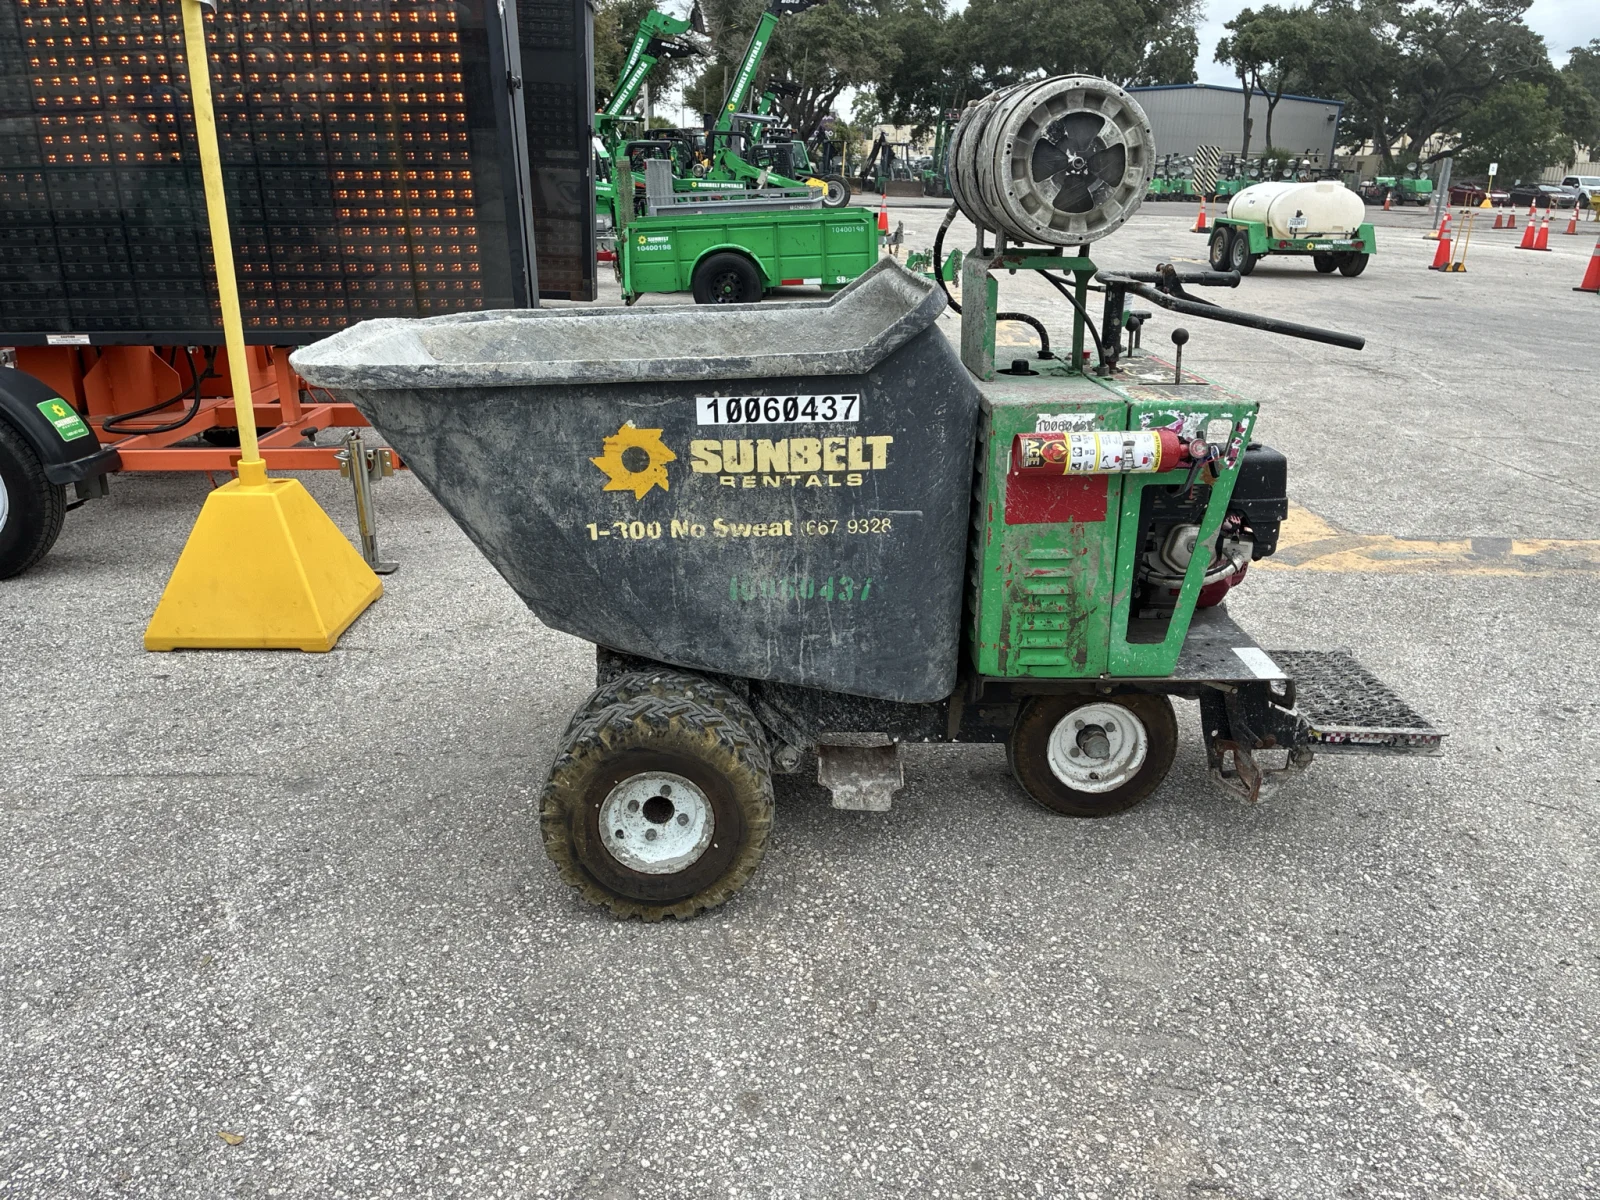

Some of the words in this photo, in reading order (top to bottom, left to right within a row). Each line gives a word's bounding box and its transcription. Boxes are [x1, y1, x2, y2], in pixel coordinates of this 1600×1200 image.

[627, 61, 648, 91] RENTALS
[731, 71, 749, 103] SUNBELT
[744, 40, 763, 73] RENTALS
[706, 396, 858, 424] 10060437
[690, 435, 894, 474] SUNBELT
[1028, 440, 1040, 465] ACE
[719, 473, 864, 489] RENTALS
[670, 519, 706, 539] No
[712, 517, 793, 538] Sweat
[847, 517, 892, 535] 9328
